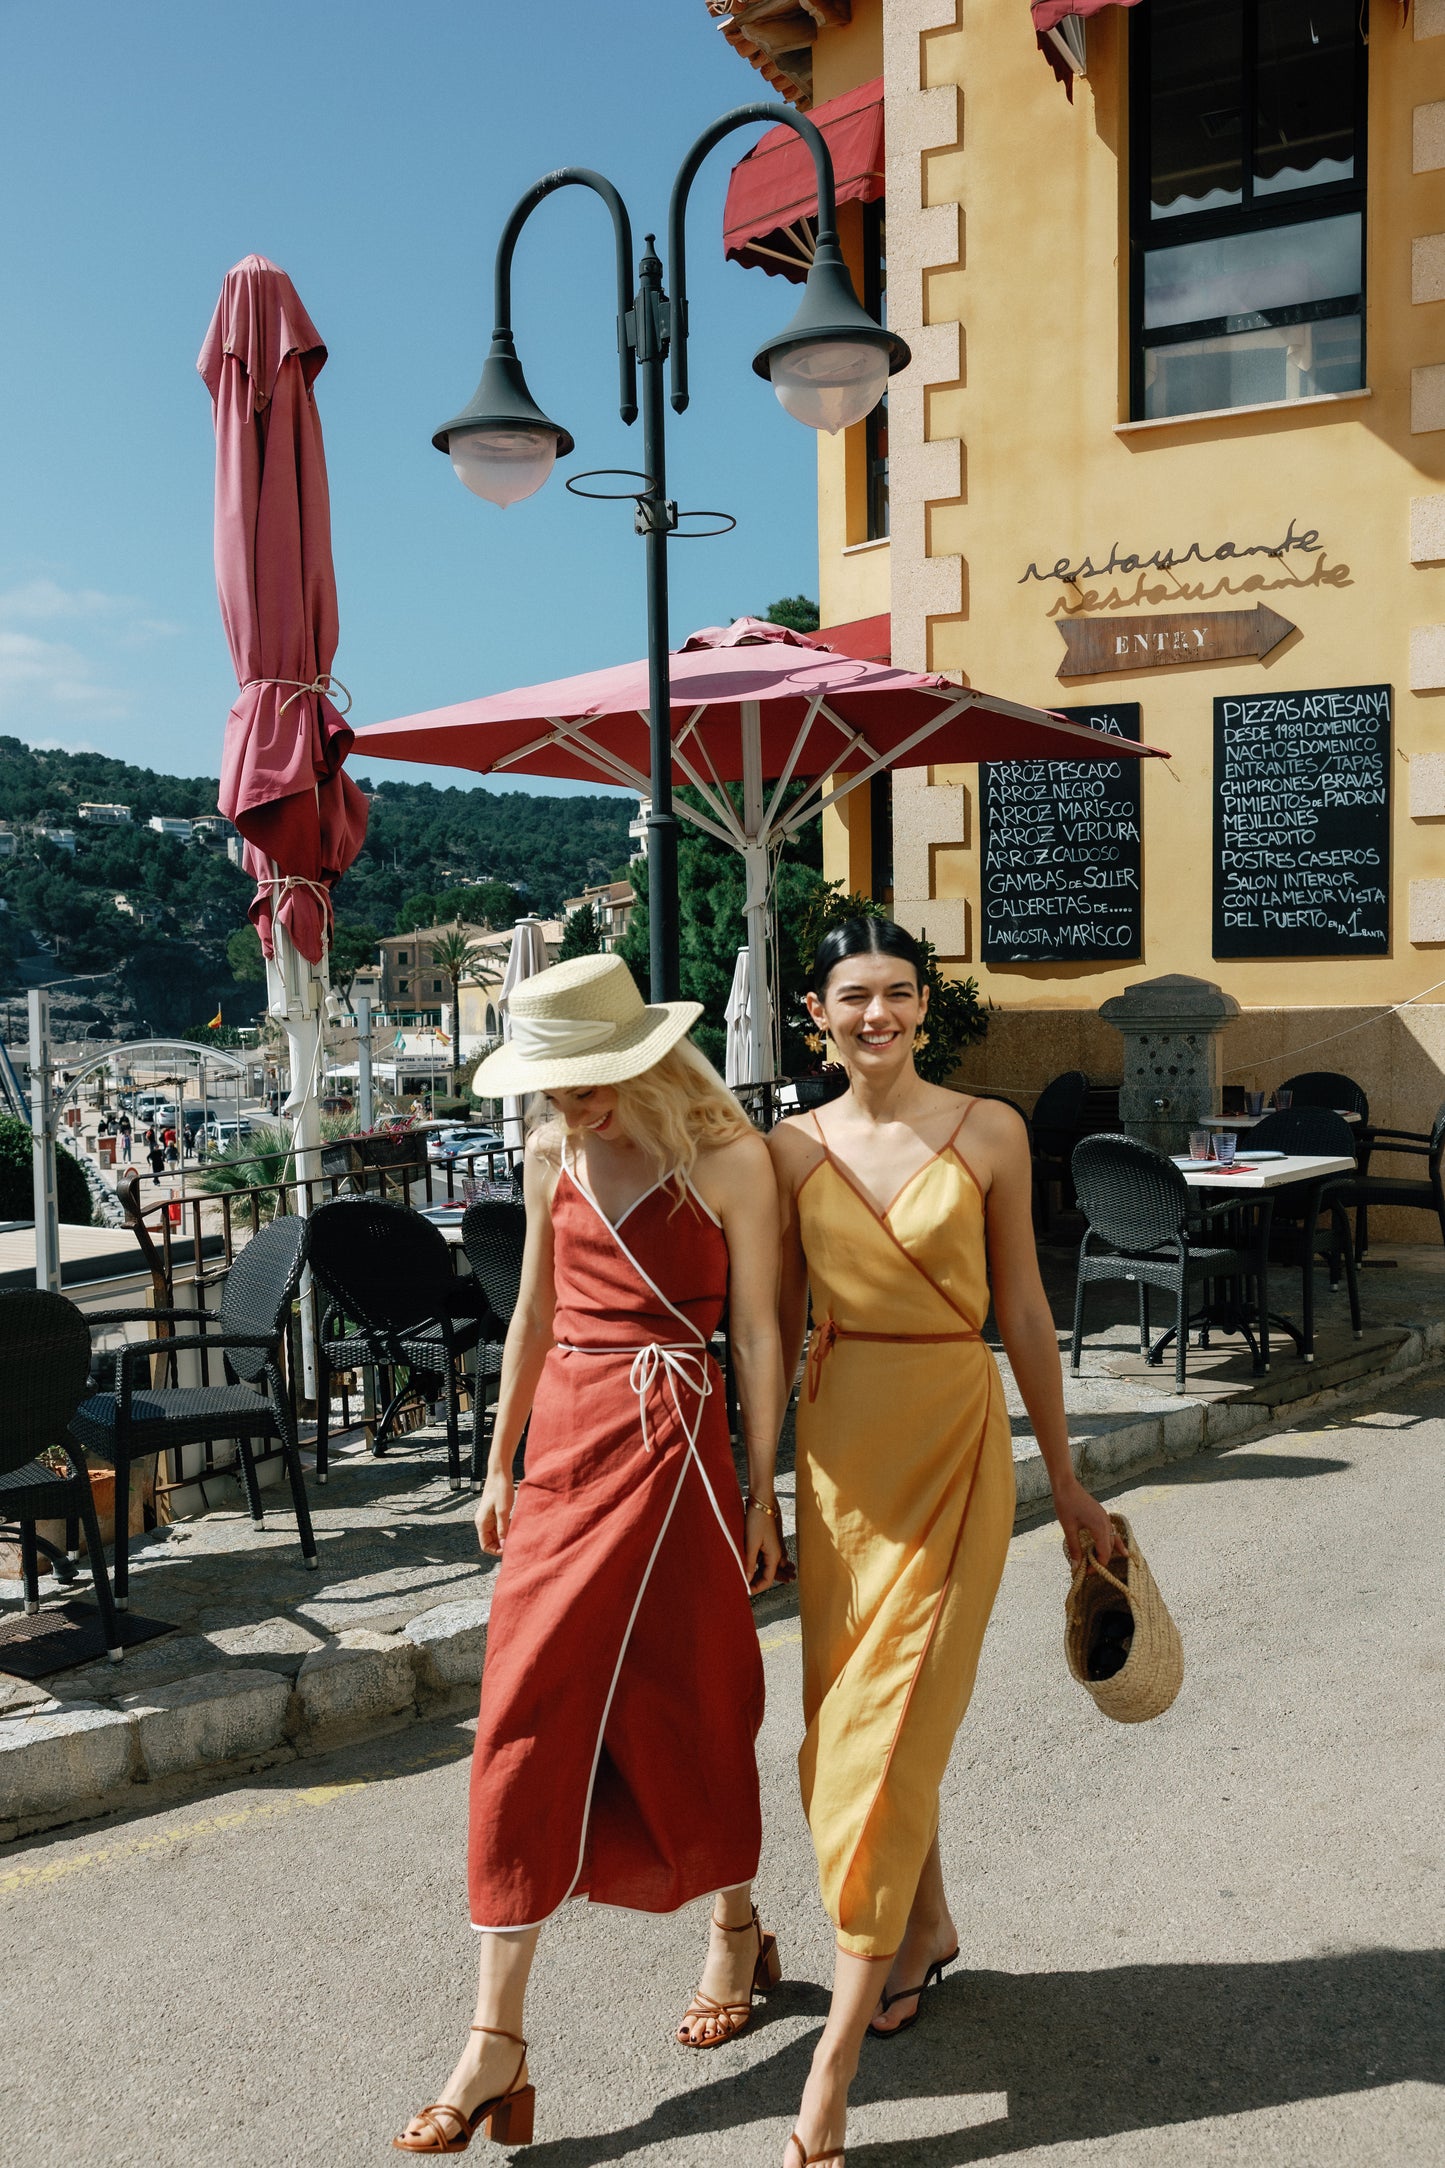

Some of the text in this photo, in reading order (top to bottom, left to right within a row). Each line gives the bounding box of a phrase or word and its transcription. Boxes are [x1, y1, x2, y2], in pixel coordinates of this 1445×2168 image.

[1017, 518, 1324, 584] restaurante
[1114, 627, 1210, 655] ENTRY
[1223, 691, 1390, 726] PIZZAS ARTESANA
[1224, 718, 1380, 744] DESDE 1989 DOMENICO
[1226, 737, 1376, 761] NACHOS DOMENICO
[987, 762, 1121, 786] ARROZ PESCADO
[1225, 758, 1318, 779] ENTRANTES
[987, 781, 1105, 806] ARROZ NEGRO
[1224, 788, 1386, 812] PIMIENTOS DE PADRON
[988, 798, 1134, 827] ARROZ MARISCO
[1222, 809, 1318, 830] MEJILLONES
[988, 821, 1141, 849] ARROZ VERDURA
[1224, 829, 1316, 847] PESCADITO
[985, 845, 1120, 871] ARROZ CALDOSO
[1222, 848, 1380, 870] POSTRES CASEROS
[988, 866, 1139, 894] GAMBAS DE SOLLER
[1224, 871, 1358, 890] SALON INTERIOR
[987, 894, 1093, 918] CALDERETAS
[1222, 887, 1385, 908] CON LA MEJOR VISTA
[1224, 911, 1259, 927] DEL
[1263, 910, 1327, 928] PUERTO
[987, 924, 1054, 944] LANGOSTA
[1059, 921, 1133, 946] MARISCO
